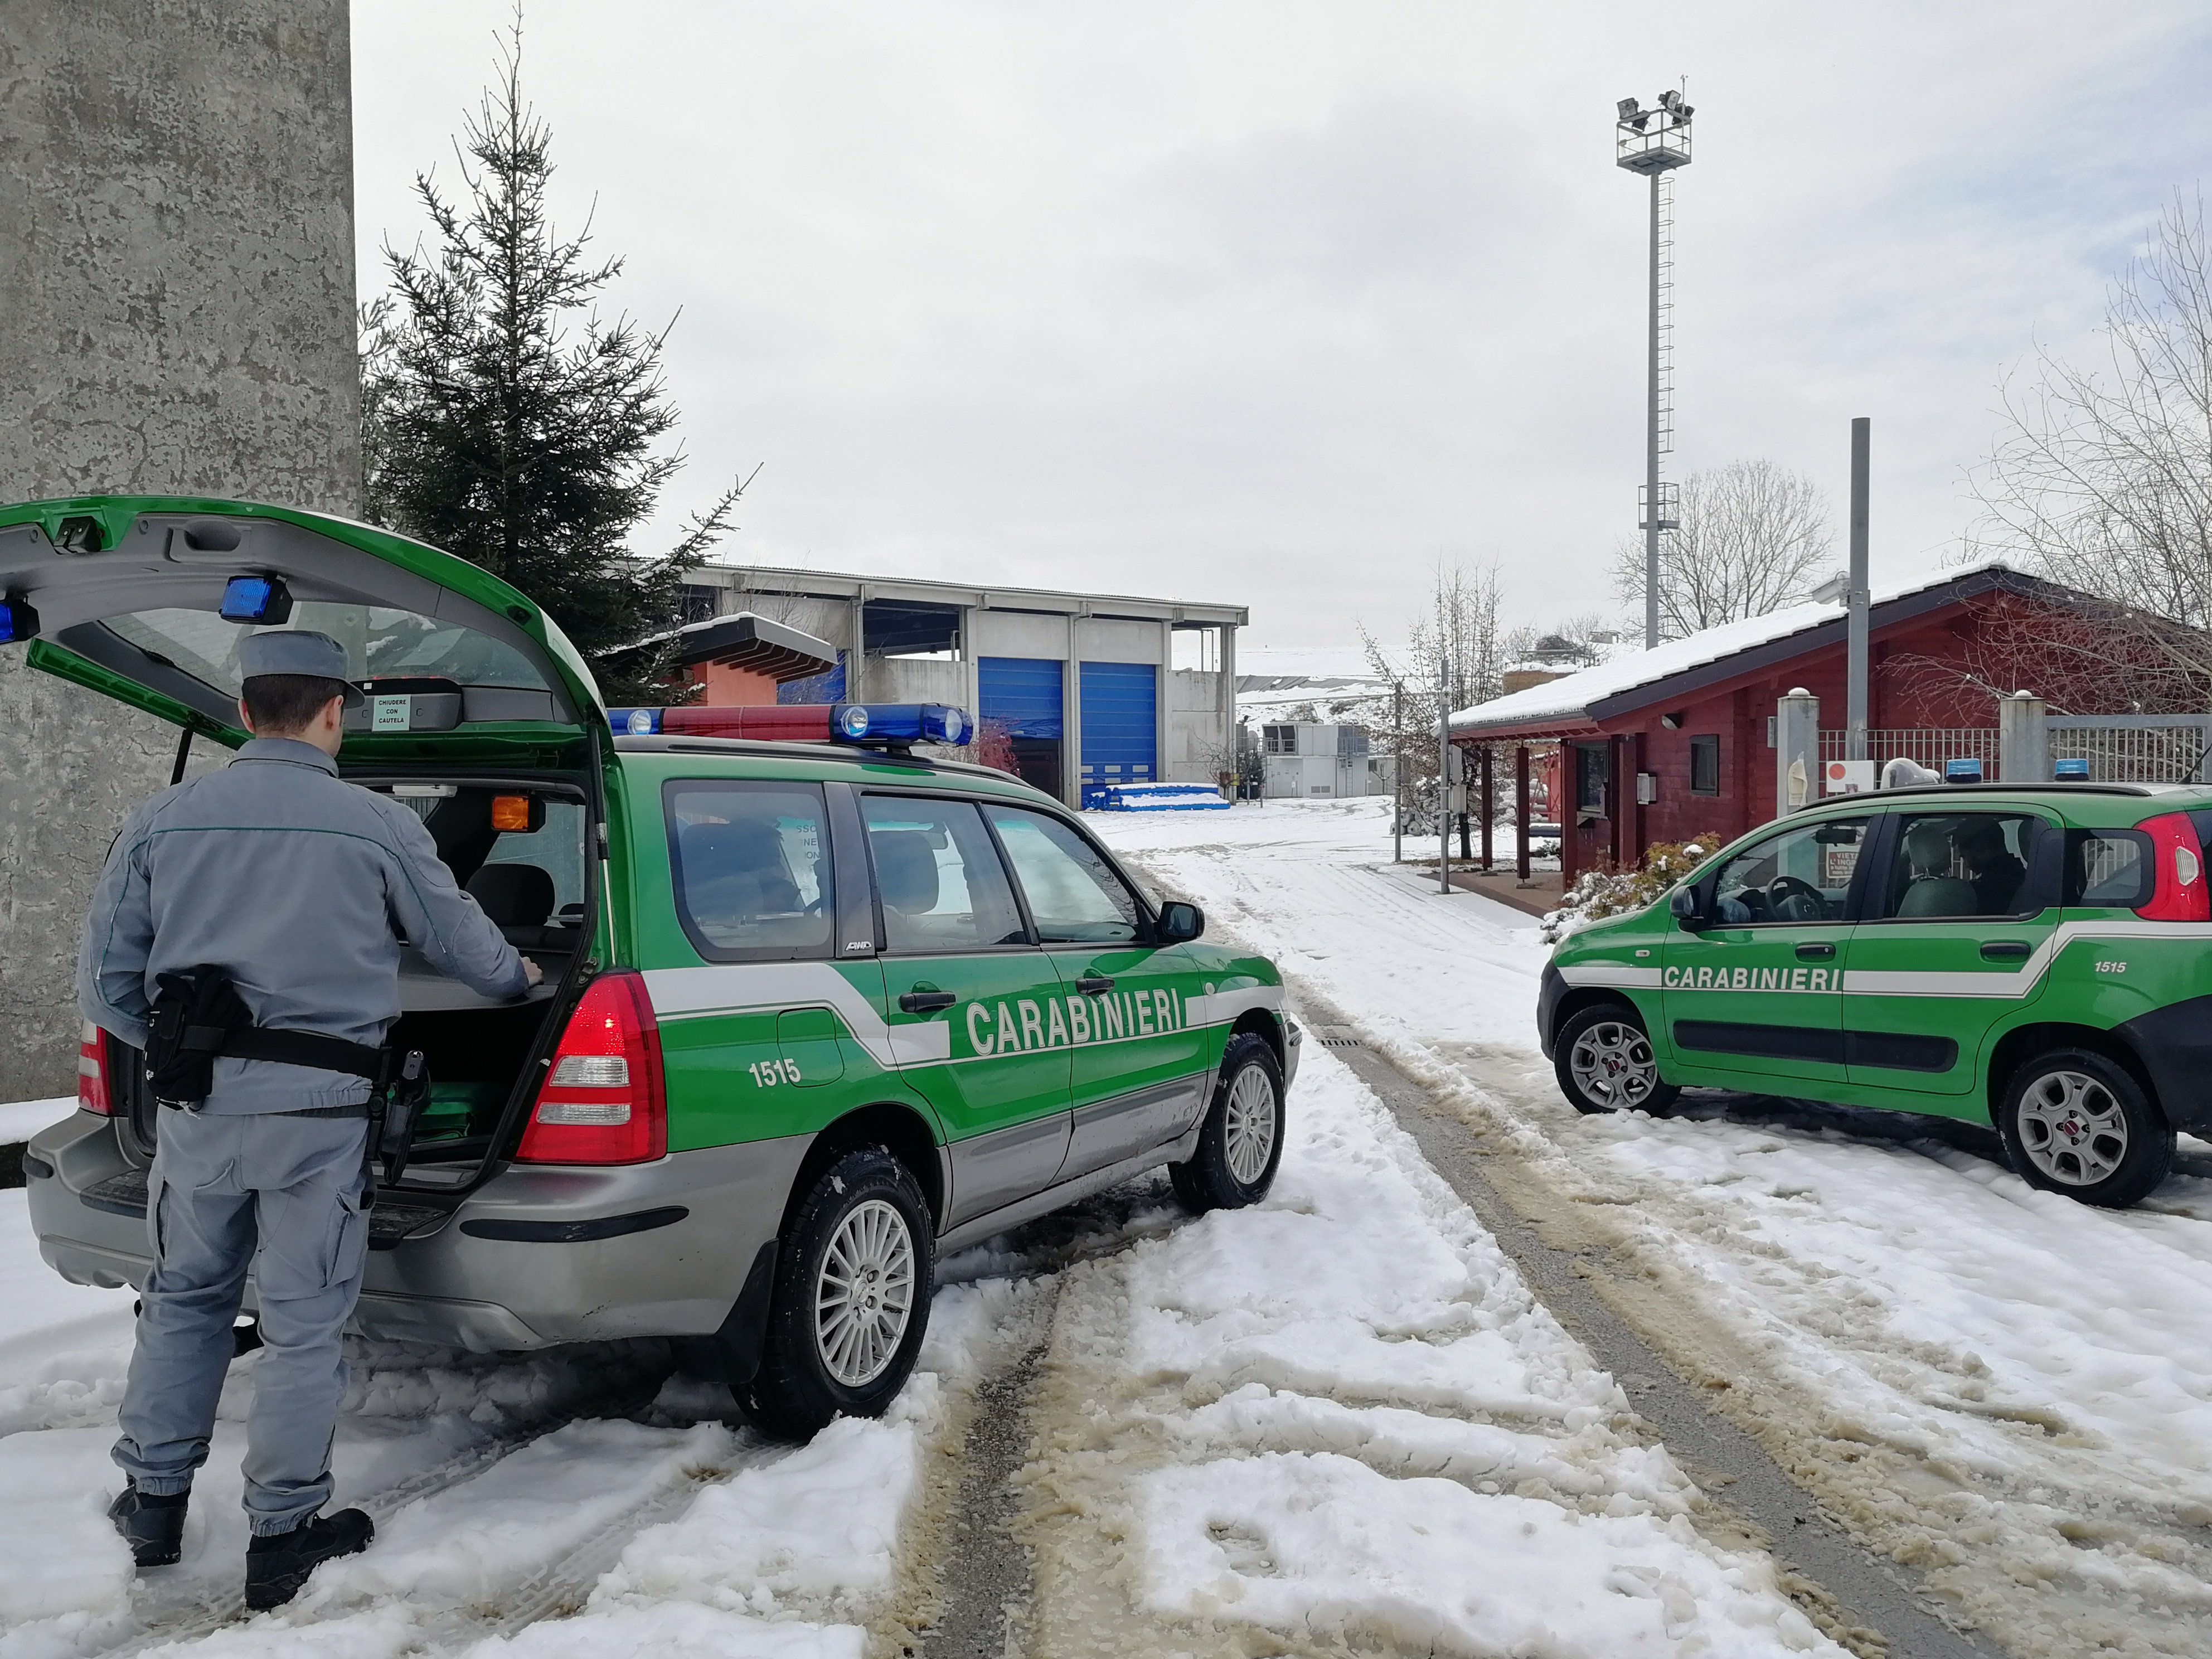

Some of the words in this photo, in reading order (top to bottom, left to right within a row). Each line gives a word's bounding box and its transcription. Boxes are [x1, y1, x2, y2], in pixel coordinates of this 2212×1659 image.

[845, 941, 871, 951] AWD
[1665, 966, 1840, 991] CARABINIERI
[2095, 961, 2127, 973] 1515
[967, 988, 1181, 1056] CARABINIERI
[749, 1058, 801, 1088] 1515
